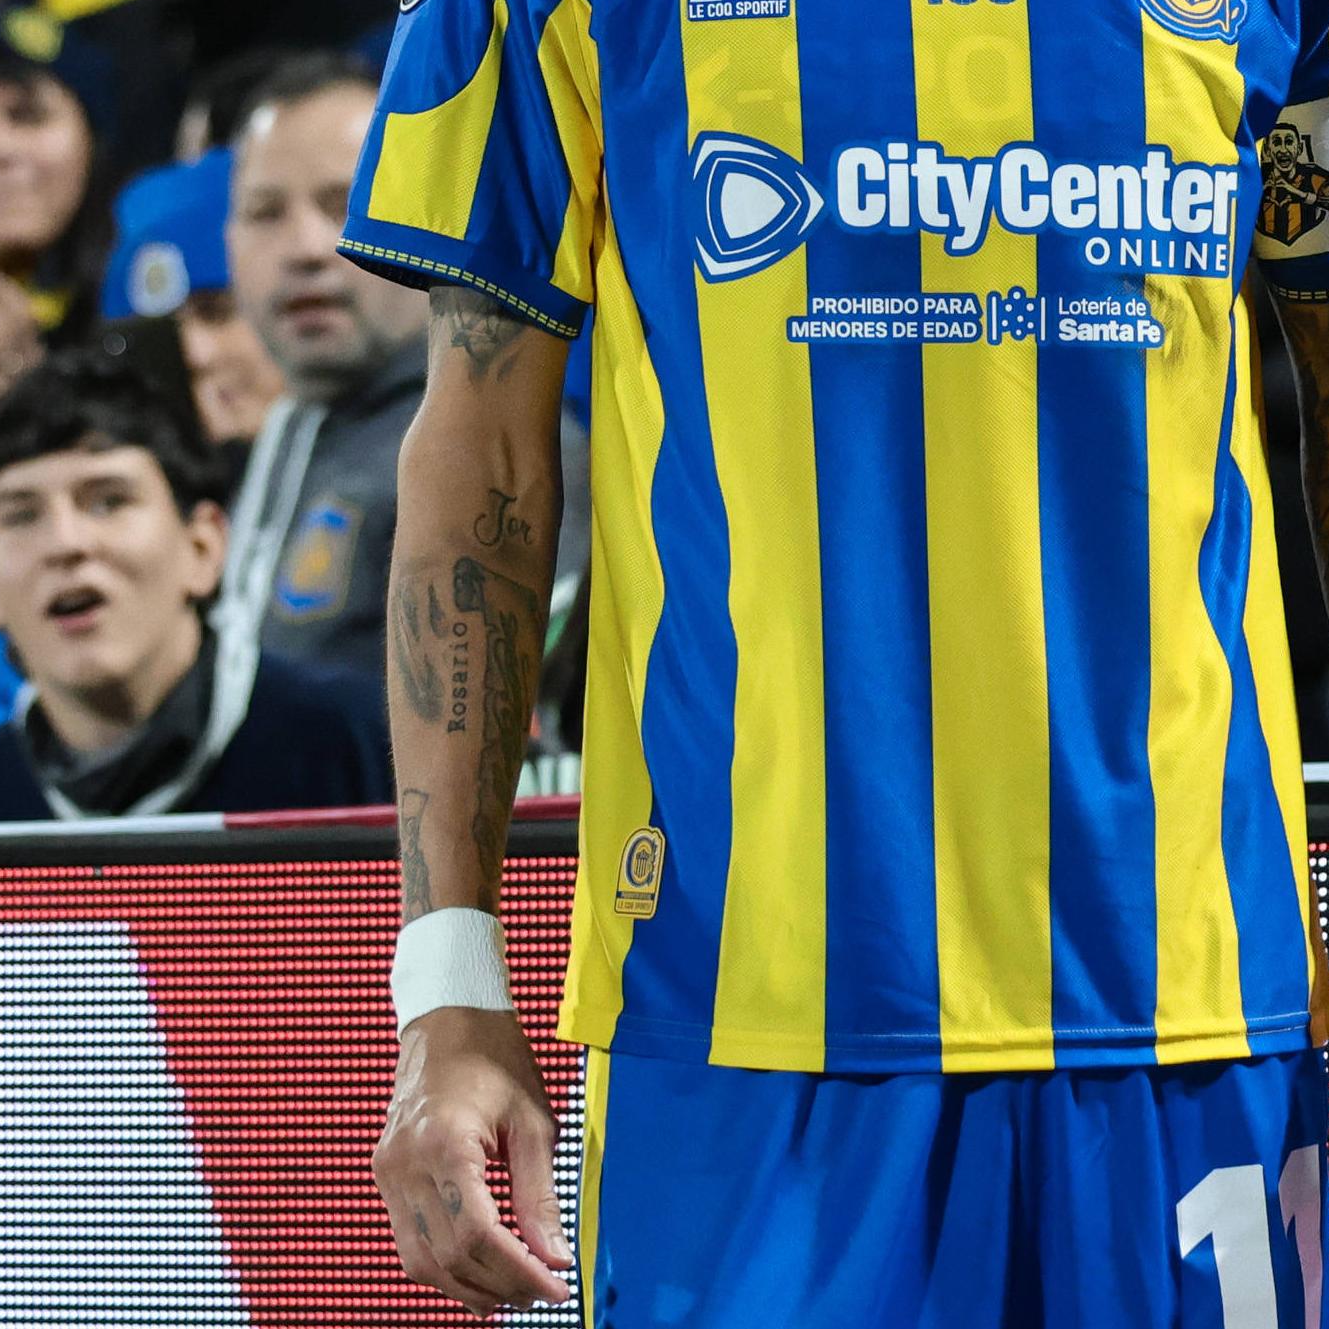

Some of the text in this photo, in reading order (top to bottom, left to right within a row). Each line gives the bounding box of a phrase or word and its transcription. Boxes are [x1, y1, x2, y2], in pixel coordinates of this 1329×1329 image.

[689, 0, 787, 18] LE COQ SPORTIF
[1084, 236, 1229, 272] ONLINE
[812, 297, 977, 315] PROHIBIDO PARA
[1058, 296, 1147, 316] Lotería de
[791, 321, 977, 338] MENORES DE EDAD
[1058, 318, 1161, 343] Santa Fe
[447, 621, 469, 735] Rosario
